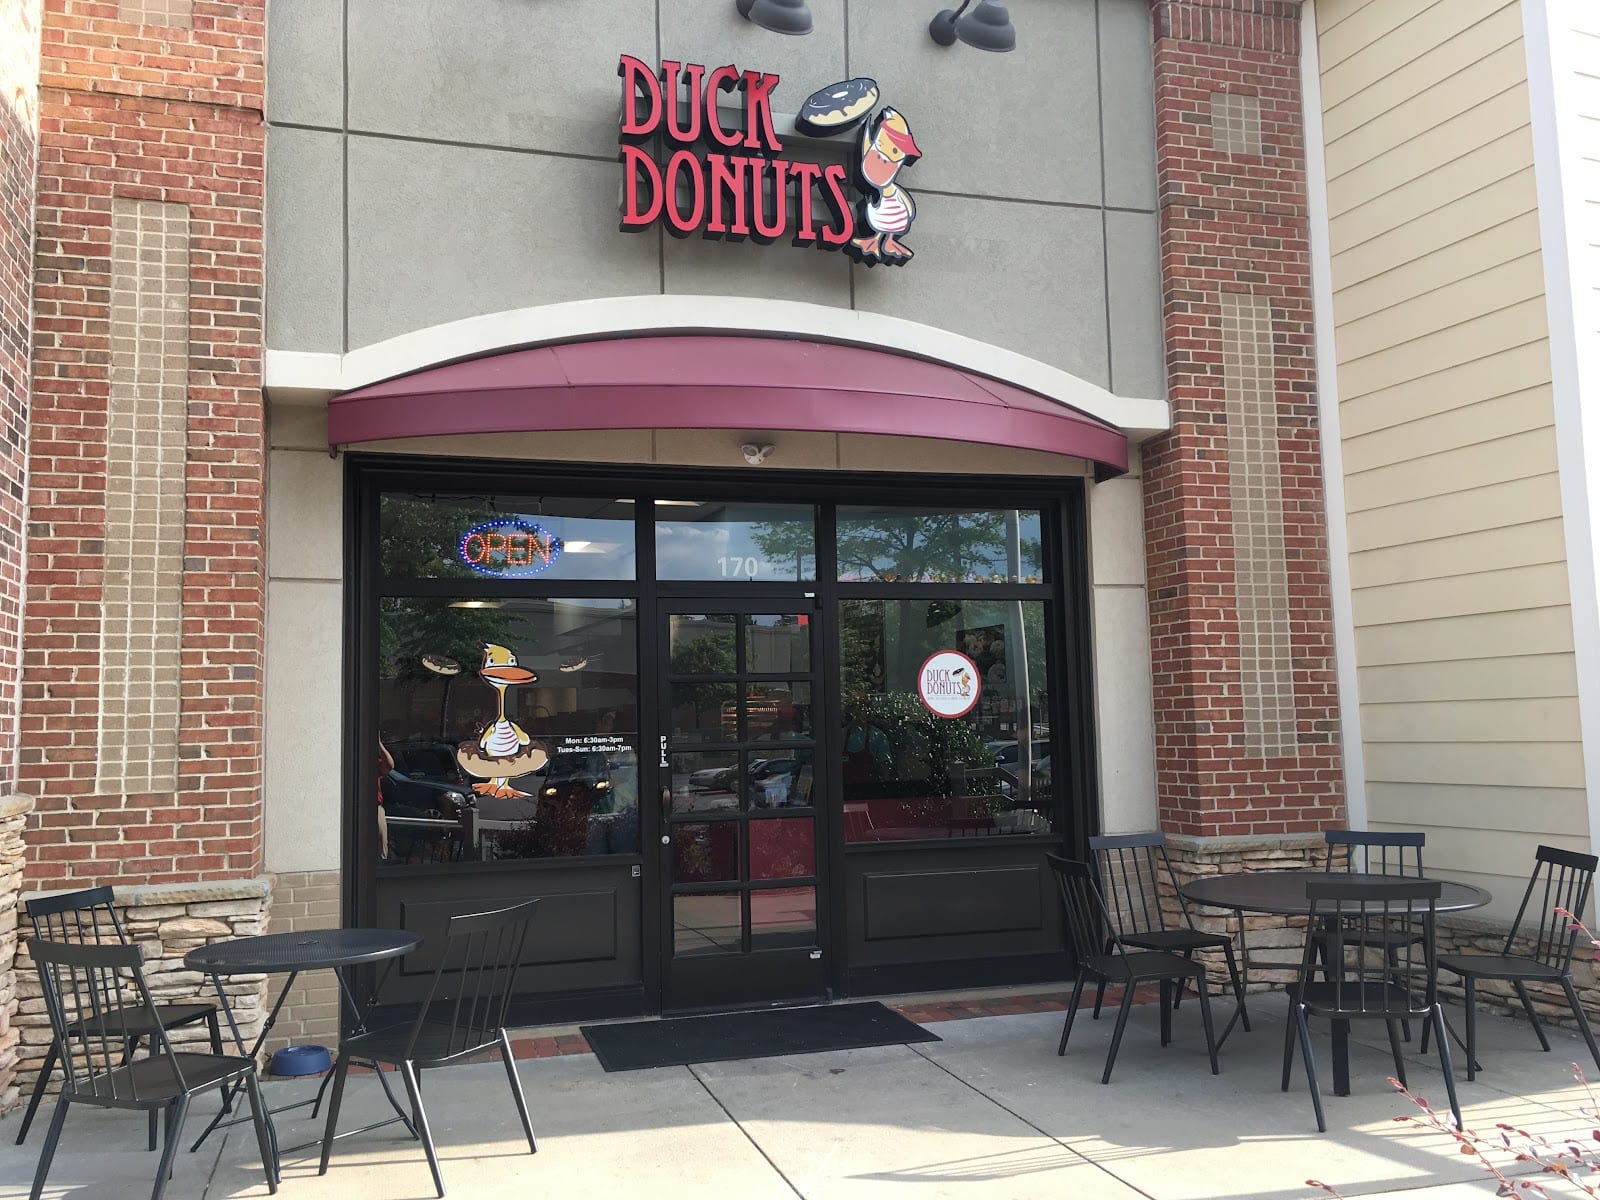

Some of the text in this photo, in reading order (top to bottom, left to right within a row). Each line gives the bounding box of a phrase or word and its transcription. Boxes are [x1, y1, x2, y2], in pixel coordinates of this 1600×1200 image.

[619, 54, 783, 152] DUCK
[620, 144, 854, 245] DONUTS
[463, 533, 551, 564] OPEN
[717, 556, 759, 577] 170
[926, 669, 951, 682] DUCK
[927, 681, 962, 695] DONUTS
